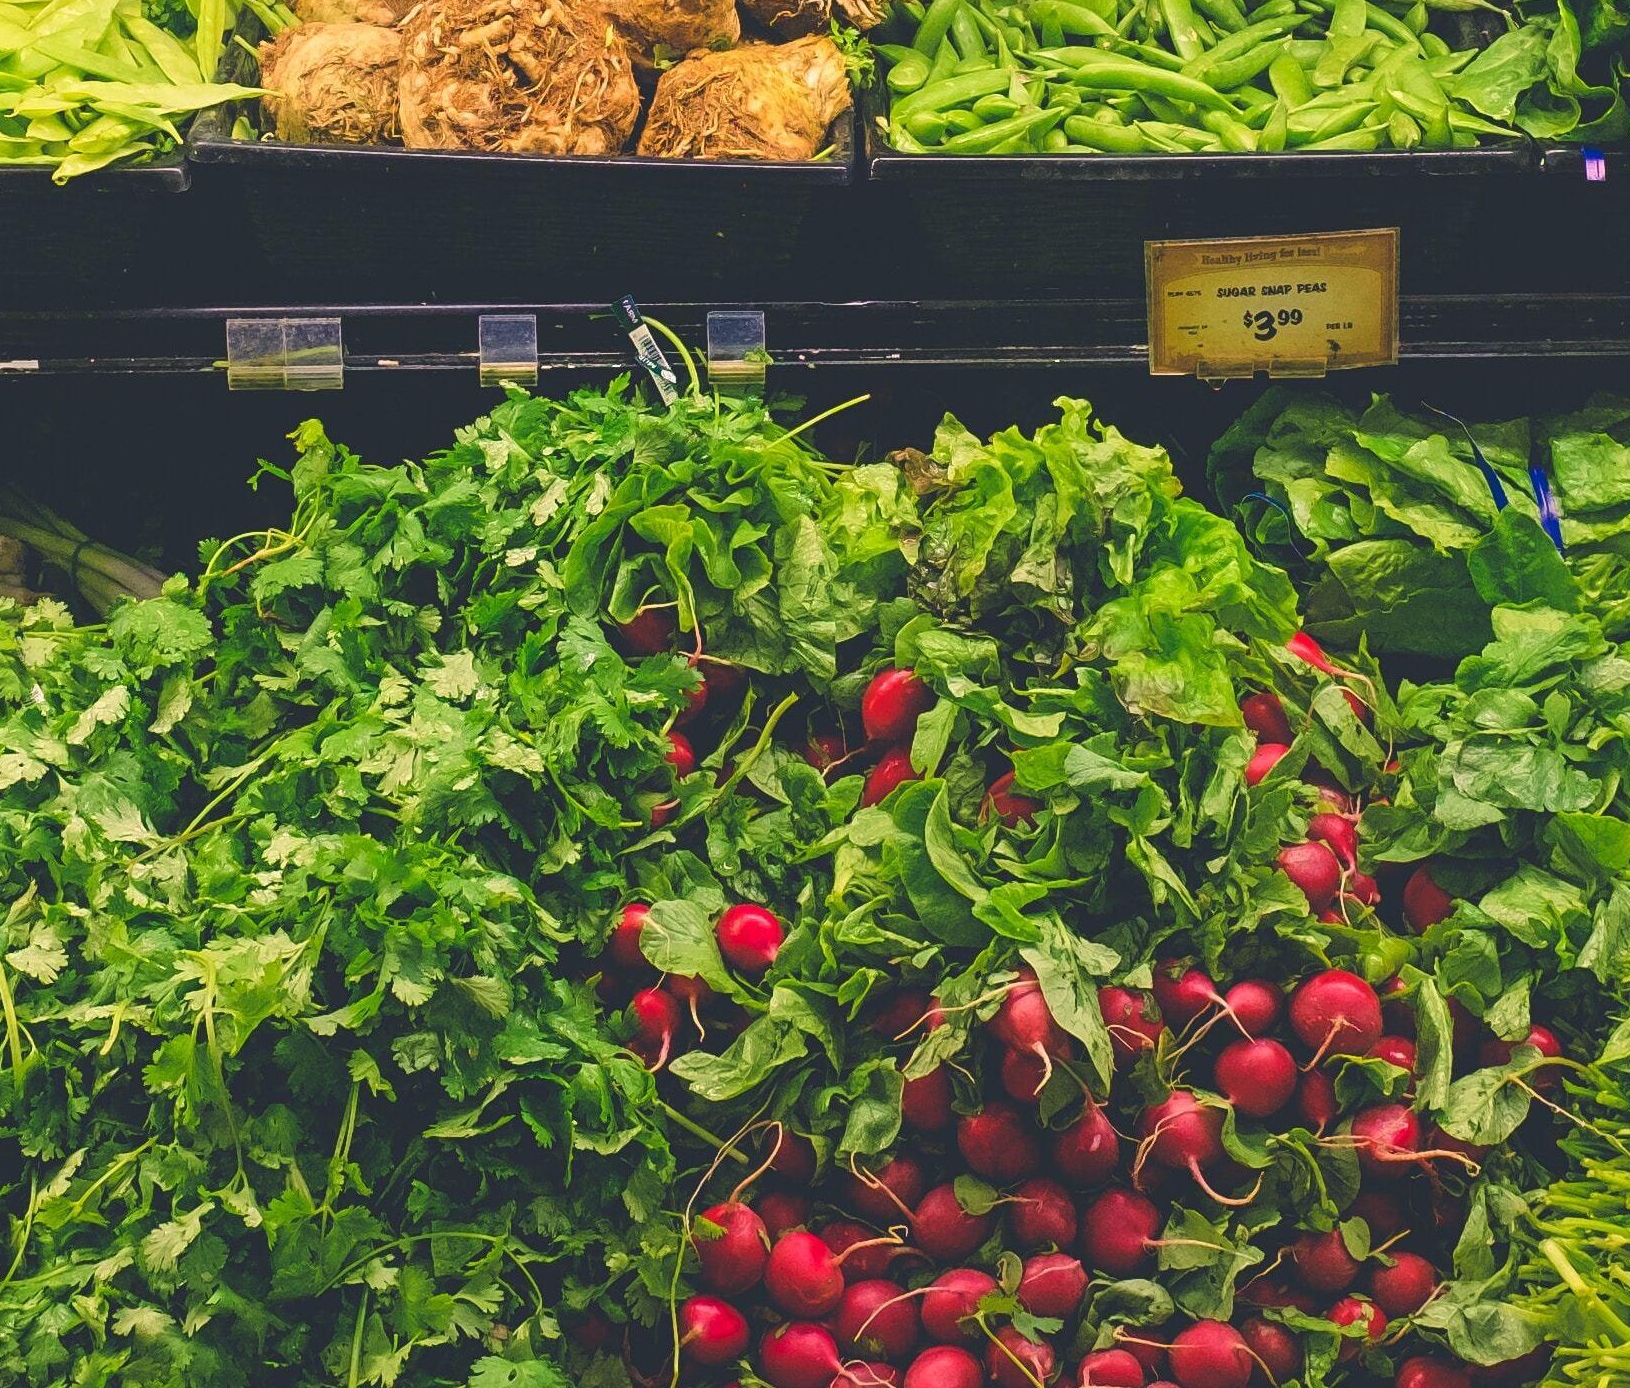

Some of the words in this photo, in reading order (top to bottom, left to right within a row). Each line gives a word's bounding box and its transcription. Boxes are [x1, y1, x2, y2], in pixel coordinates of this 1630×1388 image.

[1280, 248, 1294, 258] for
[1216, 286, 1255, 298] SUGAR
[1261, 284, 1292, 296] SNAP
[1297, 283, 1327, 293] PEAS
